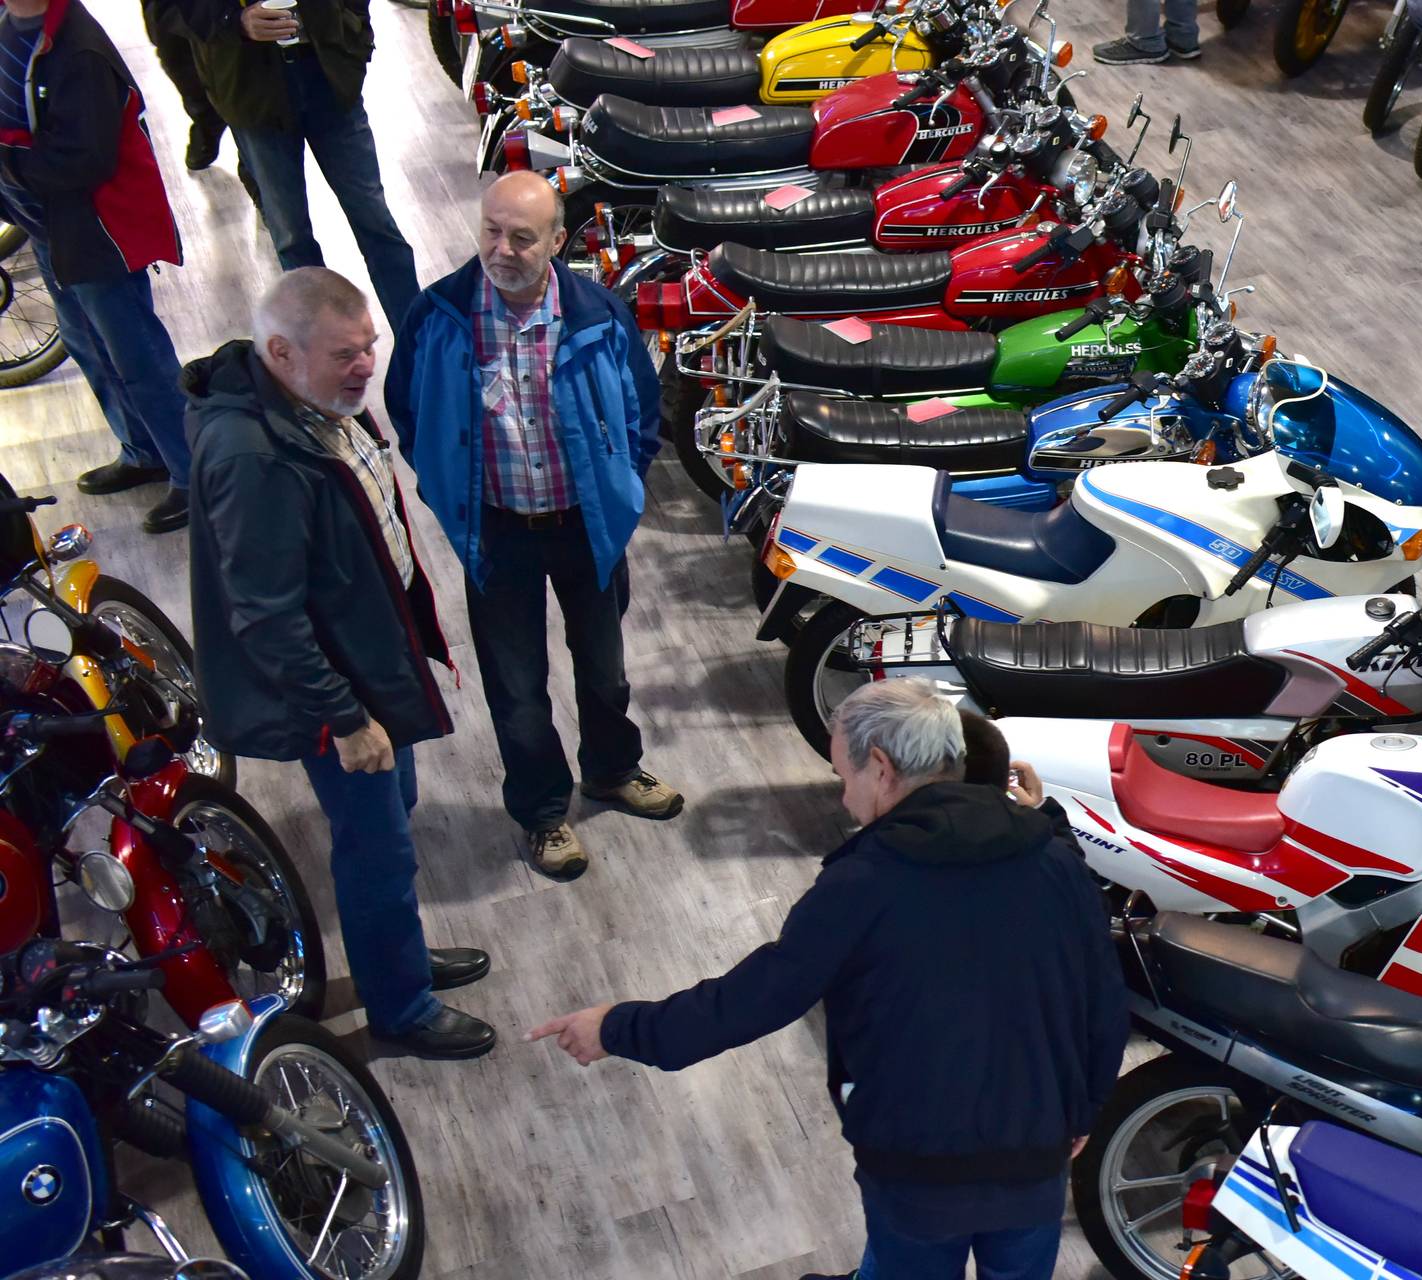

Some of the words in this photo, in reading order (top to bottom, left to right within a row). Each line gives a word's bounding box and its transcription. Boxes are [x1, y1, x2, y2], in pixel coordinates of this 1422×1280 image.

[919, 125, 973, 140] HERCULES
[926, 223, 1000, 236] HERCULES
[991, 290, 1069, 303] HERCULES
[1185, 751, 1214, 768] 80
[1219, 752, 1248, 768] PL
[1292, 1074, 1346, 1097] LIGHT
[1286, 1082, 1377, 1121] SPRINTER
